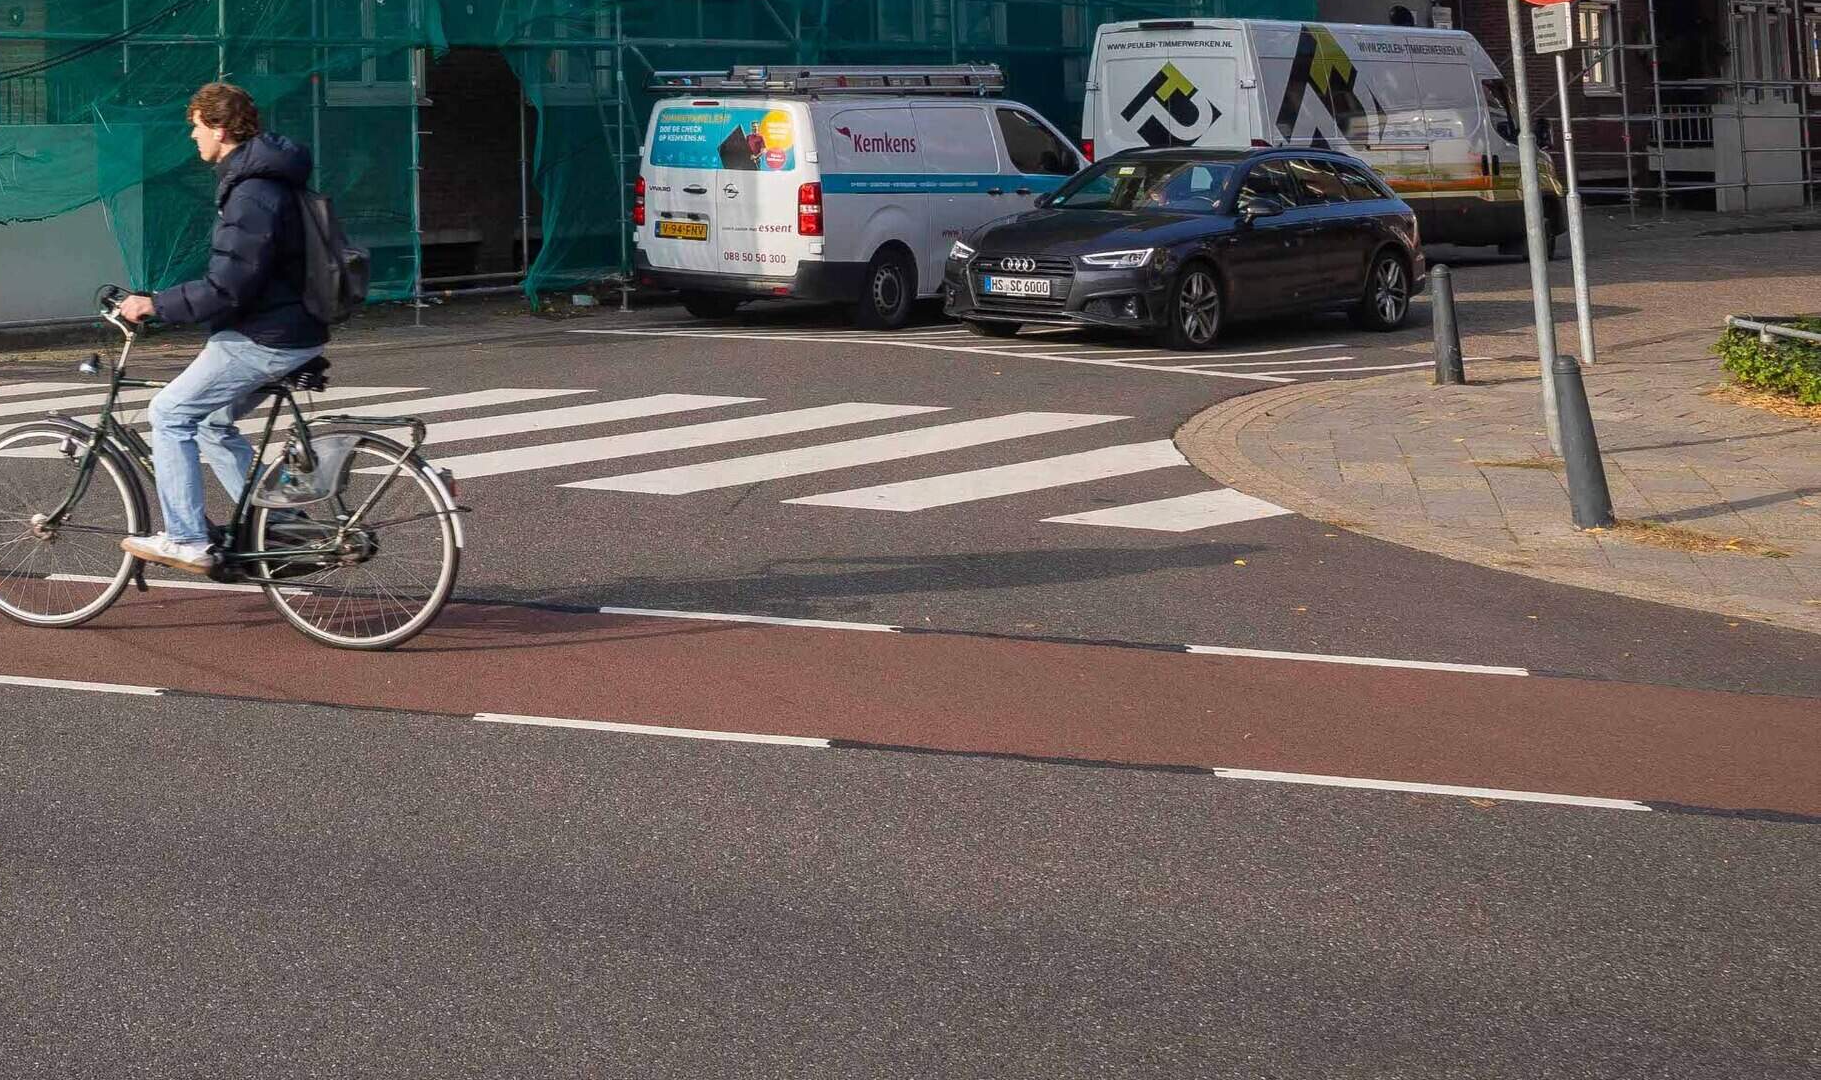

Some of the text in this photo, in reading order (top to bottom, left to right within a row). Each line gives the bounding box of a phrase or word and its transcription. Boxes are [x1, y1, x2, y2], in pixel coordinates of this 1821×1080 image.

[1106, 40, 1233, 50] WWW.PEULEN-TIMMERWERKEN.NL
[853, 132, 916, 153] Kemkens
[758, 223, 792, 233] essent
[723, 251, 786, 264] 088 50 50 300
[992, 280, 1049, 294] HS SC 6000
